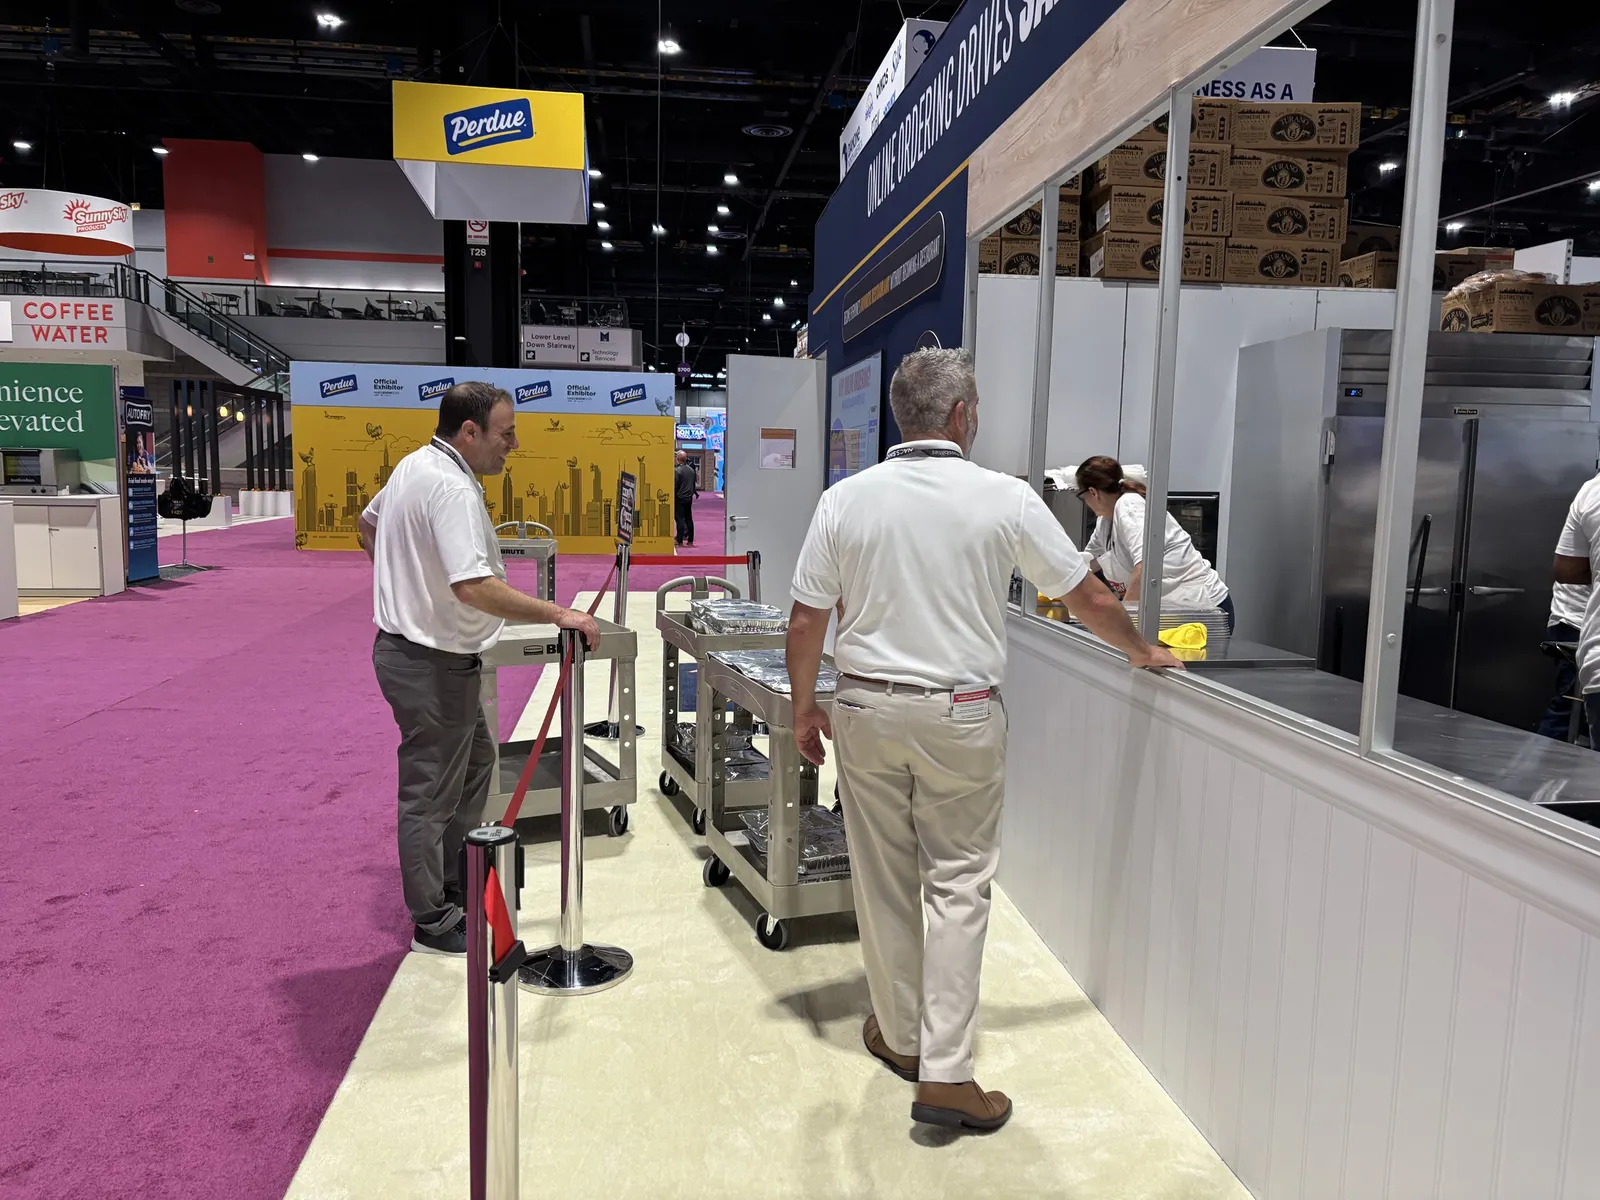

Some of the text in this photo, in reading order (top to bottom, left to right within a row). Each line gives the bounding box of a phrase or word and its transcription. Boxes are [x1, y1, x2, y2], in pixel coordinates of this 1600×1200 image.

[1250, 82, 1275, 99] AS
[1280, 83, 1294, 100] A
[867, 0, 1014, 218] ONLINE ORDERING DRIVES
[450, 109, 526, 143] Perdue
[1281, 116, 1310, 126] TURANO
[1271, 163, 1299, 173] TURANO
[75, 206, 127, 224] SunnySky
[1275, 210, 1302, 220] TURANO
[77, 224, 106, 232] PRODUCTS
[470, 248, 487, 257] T28
[1268, 254, 1294, 264] TURANO
[23, 302, 114, 321] COFFEE
[1446, 310, 1465, 321] TURANO
[31, 325, 108, 344] WATER
[547, 342, 575, 350] Stairway
[0, 379, 84, 404] nience
[322, 378, 355, 394] Perdue
[421, 381, 452, 396] Perdue
[517, 384, 549, 399] Perdue
[612, 387, 644, 402] Perdue
[0, 410, 84, 433] evated
[127, 407, 152, 421] AUTOFRY
